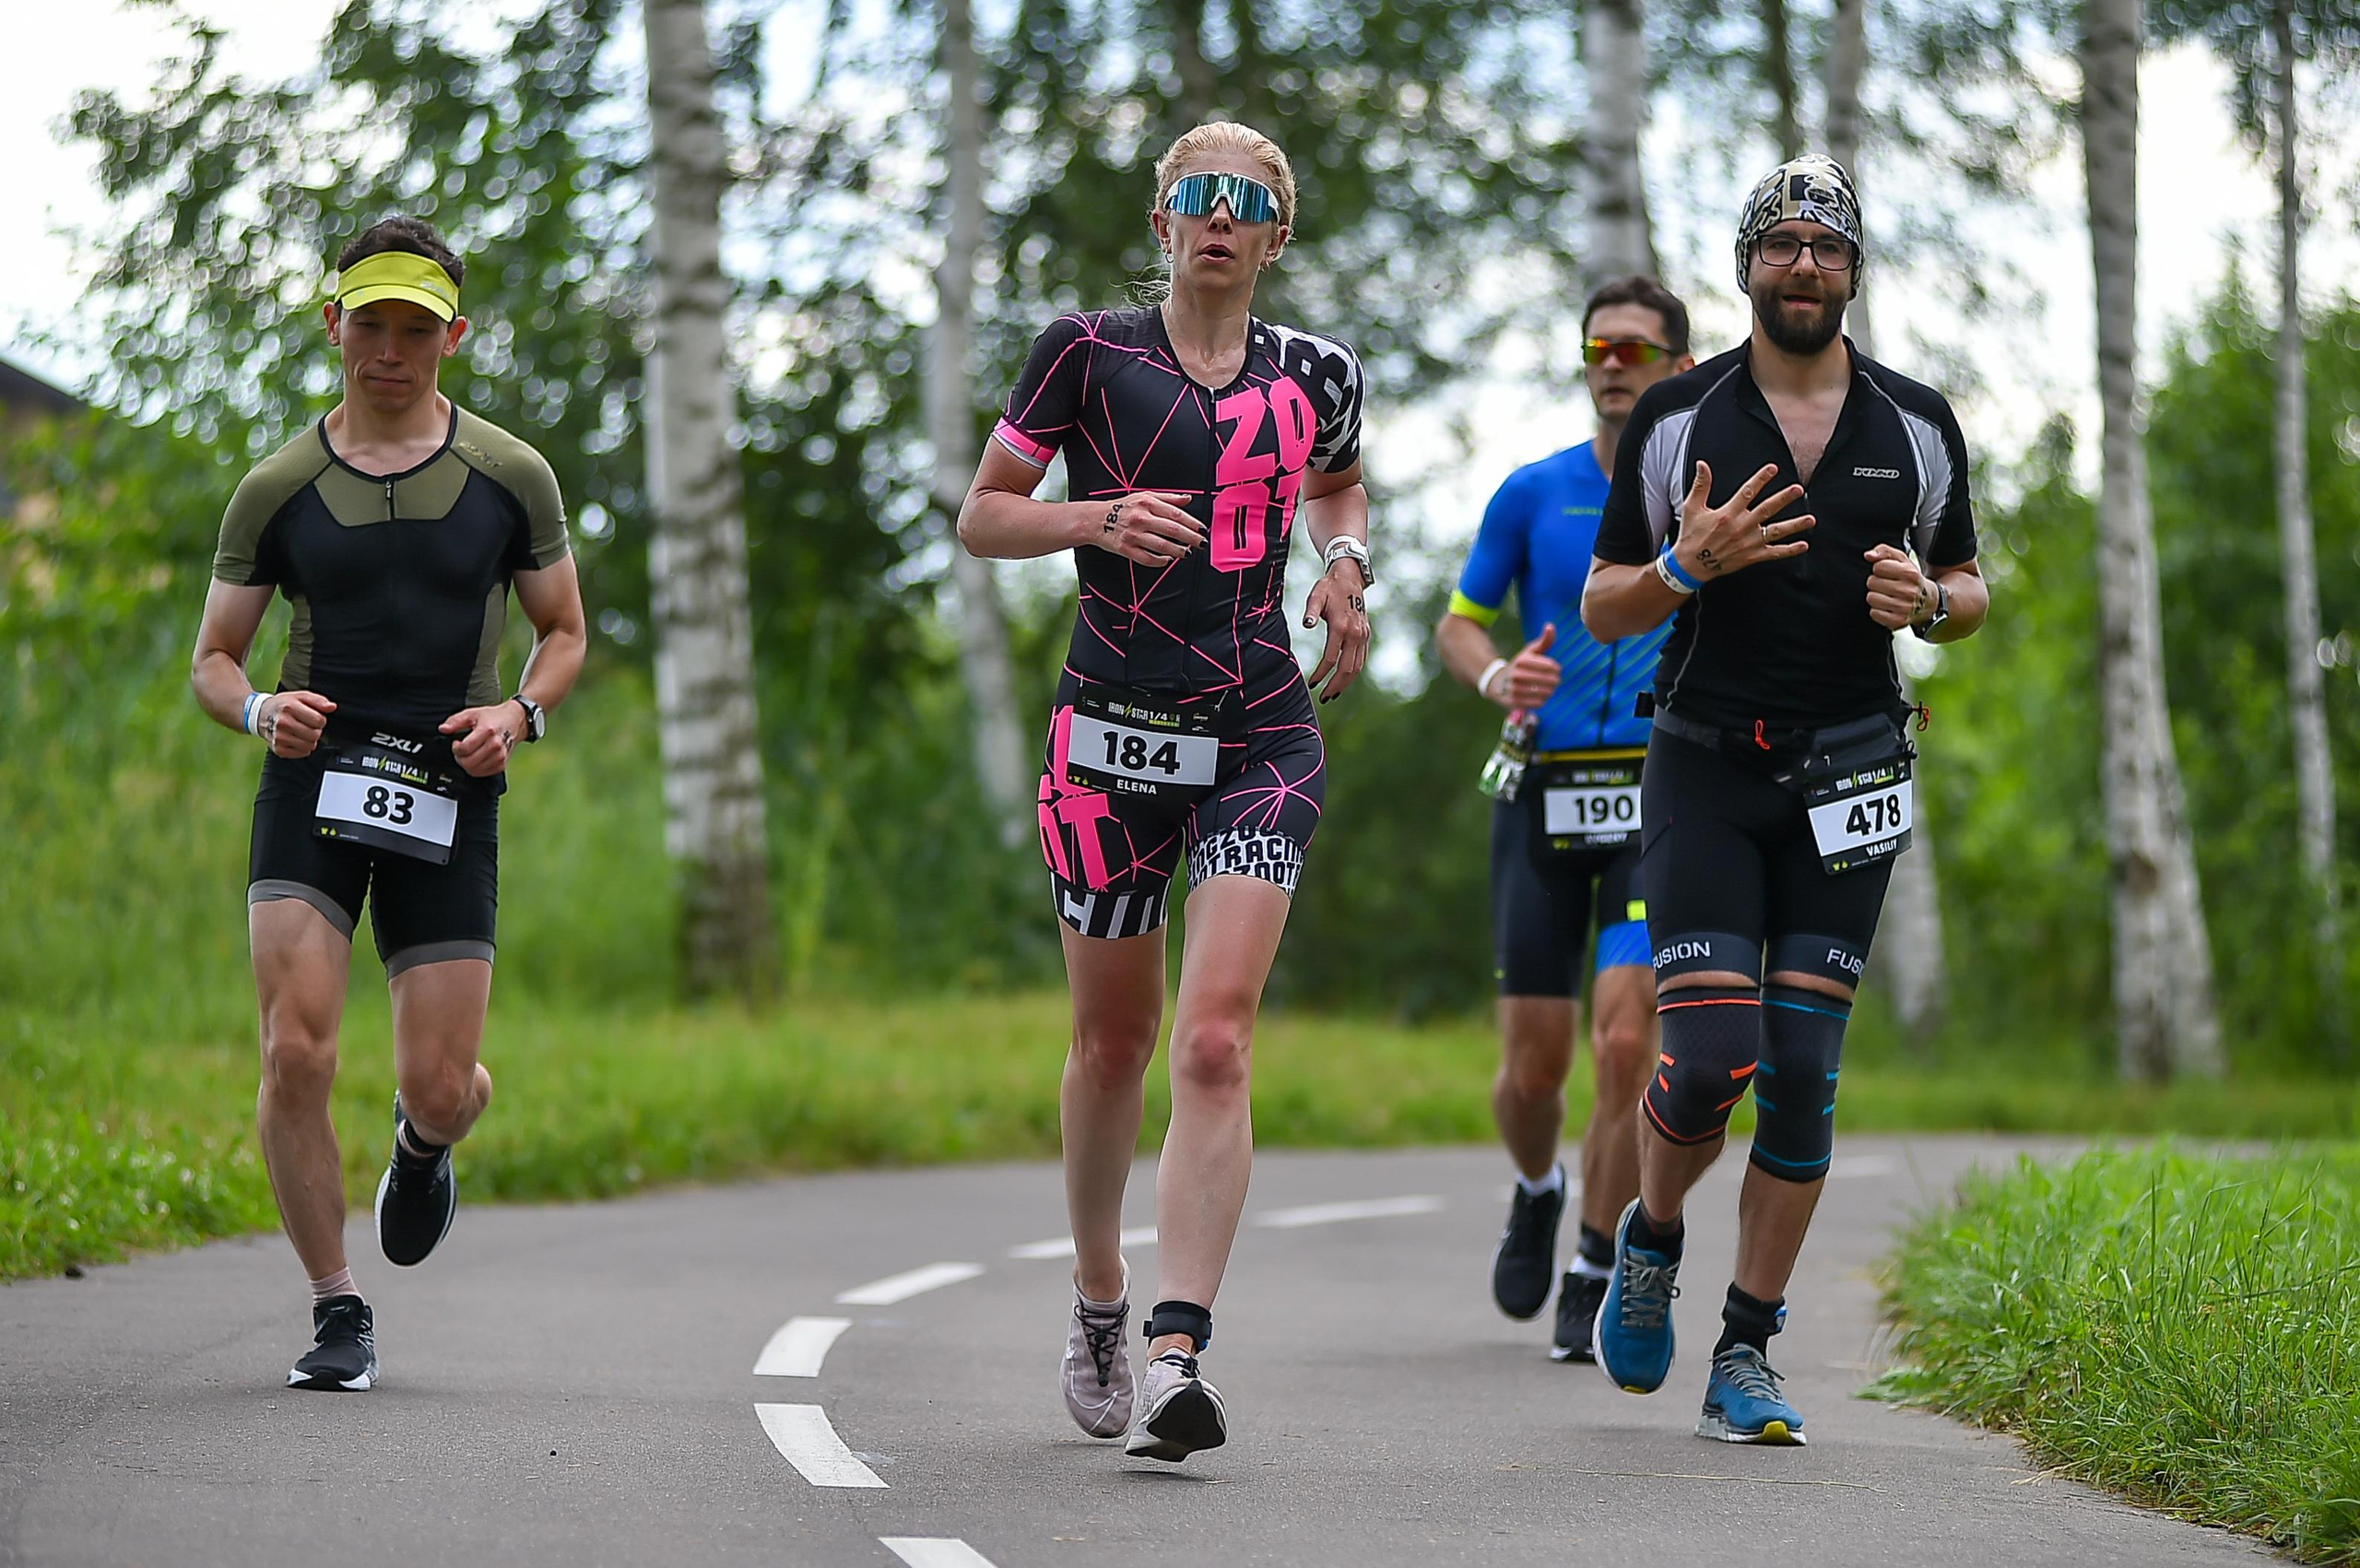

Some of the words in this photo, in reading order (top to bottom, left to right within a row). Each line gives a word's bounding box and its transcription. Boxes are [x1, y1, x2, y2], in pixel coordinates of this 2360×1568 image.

[1103, 503, 1124, 533] 184
[1108, 701, 1125, 715] IRON
[1131, 707, 1149, 721] STAR
[1150, 711, 1168, 721] 1/4
[1103, 731, 1181, 775] 184
[1116, 779, 1157, 795] ELENA
[362, 785, 415, 825] 83
[1575, 795, 1634, 824] 190
[1846, 794, 1901, 836] 478
